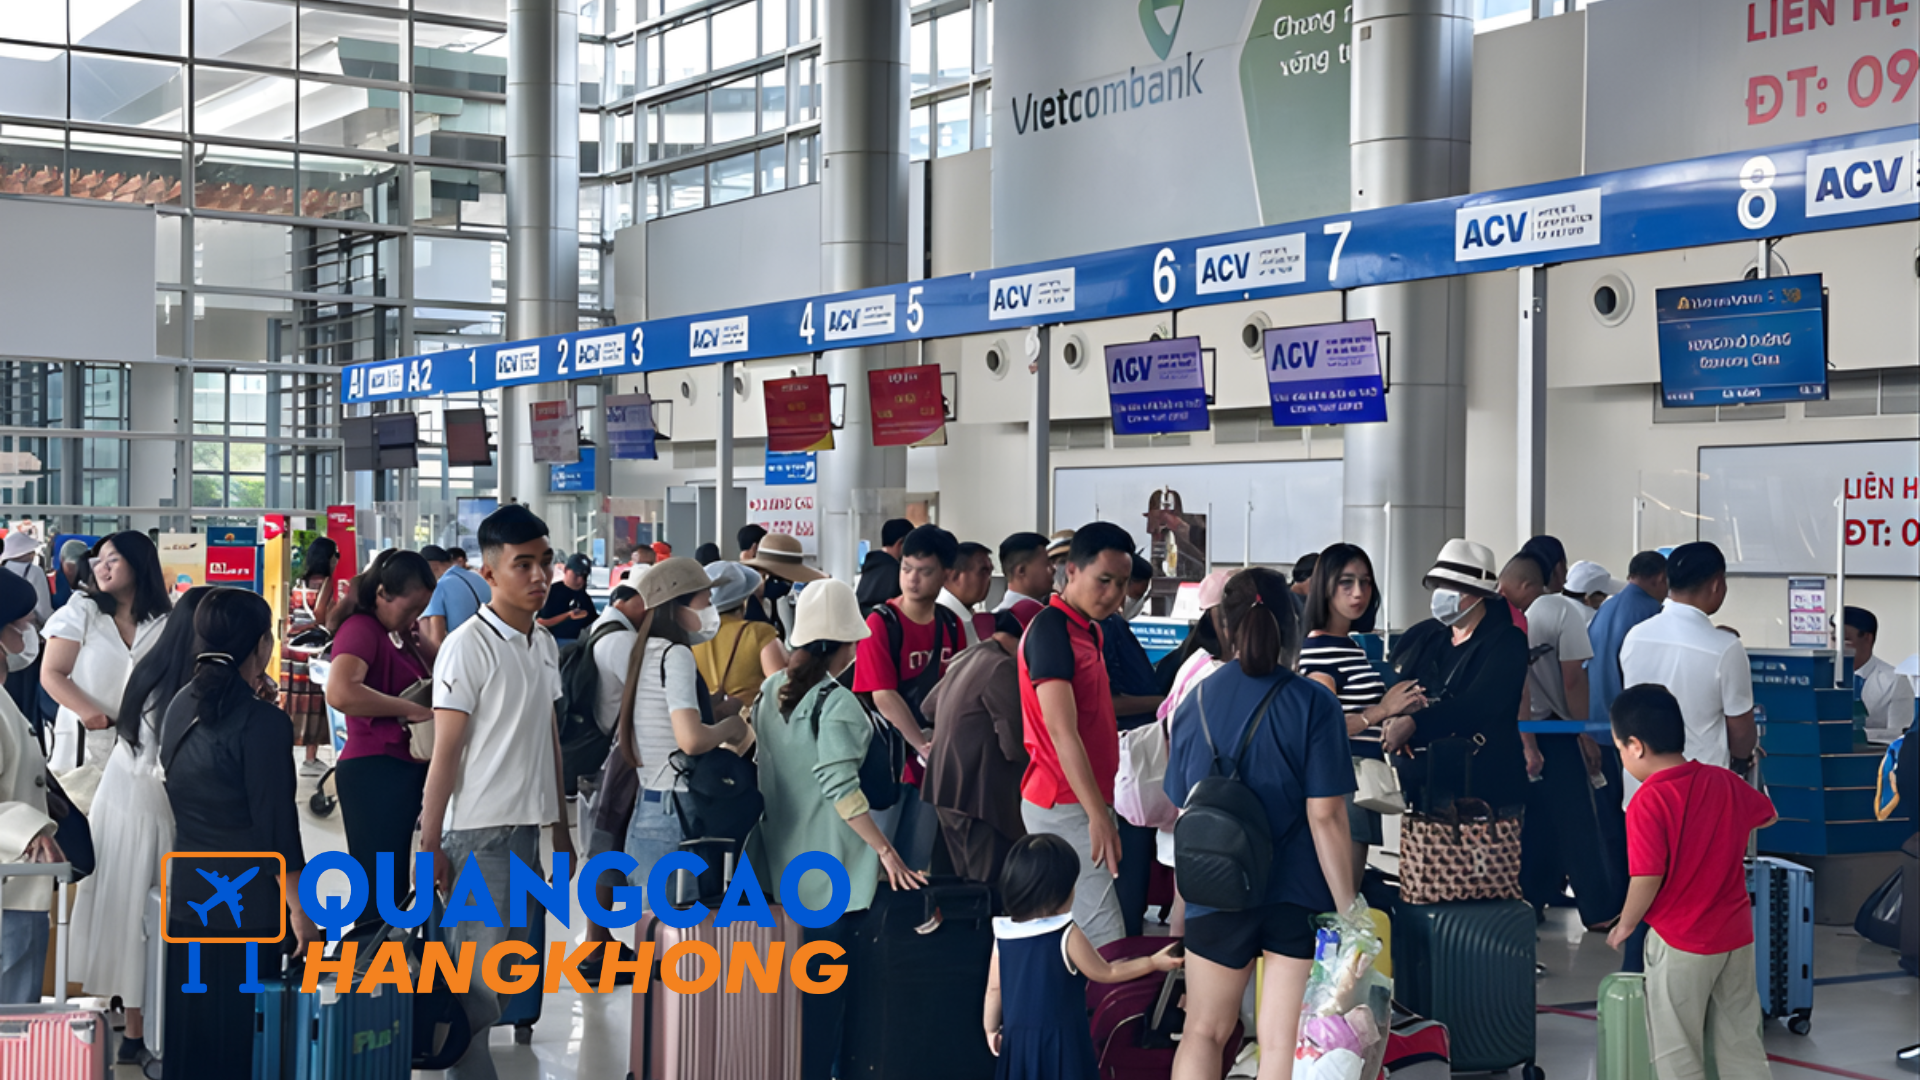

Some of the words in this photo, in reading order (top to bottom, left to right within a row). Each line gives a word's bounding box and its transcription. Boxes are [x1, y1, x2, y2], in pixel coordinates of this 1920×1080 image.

[1012, 51, 1205, 135] Vietcombank
[1745, 65, 1829, 126] ĐT:
[1848, 48, 1920, 109] 09
[1737, 155, 1778, 230] 8
[1815, 156, 1905, 202] ACV
[1462, 211, 1529, 250] ACV
[1202, 252, 1250, 285] ACV
[1323, 221, 1352, 282] 7
[1153, 247, 1177, 303] 6
[906, 286, 925, 333] 5
[993, 283, 1033, 312] ACV
[799, 301, 816, 346] 4
[557, 338, 569, 375] 2
[631, 326, 644, 366] 3
[1271, 339, 1320, 372] ACV
[407, 358, 433, 393] A2
[468, 348, 476, 385] 1
[1112, 354, 1154, 384] ACV
[1844, 471, 1895, 500] LIÊN
[1844, 518, 1892, 547] ĐT:
